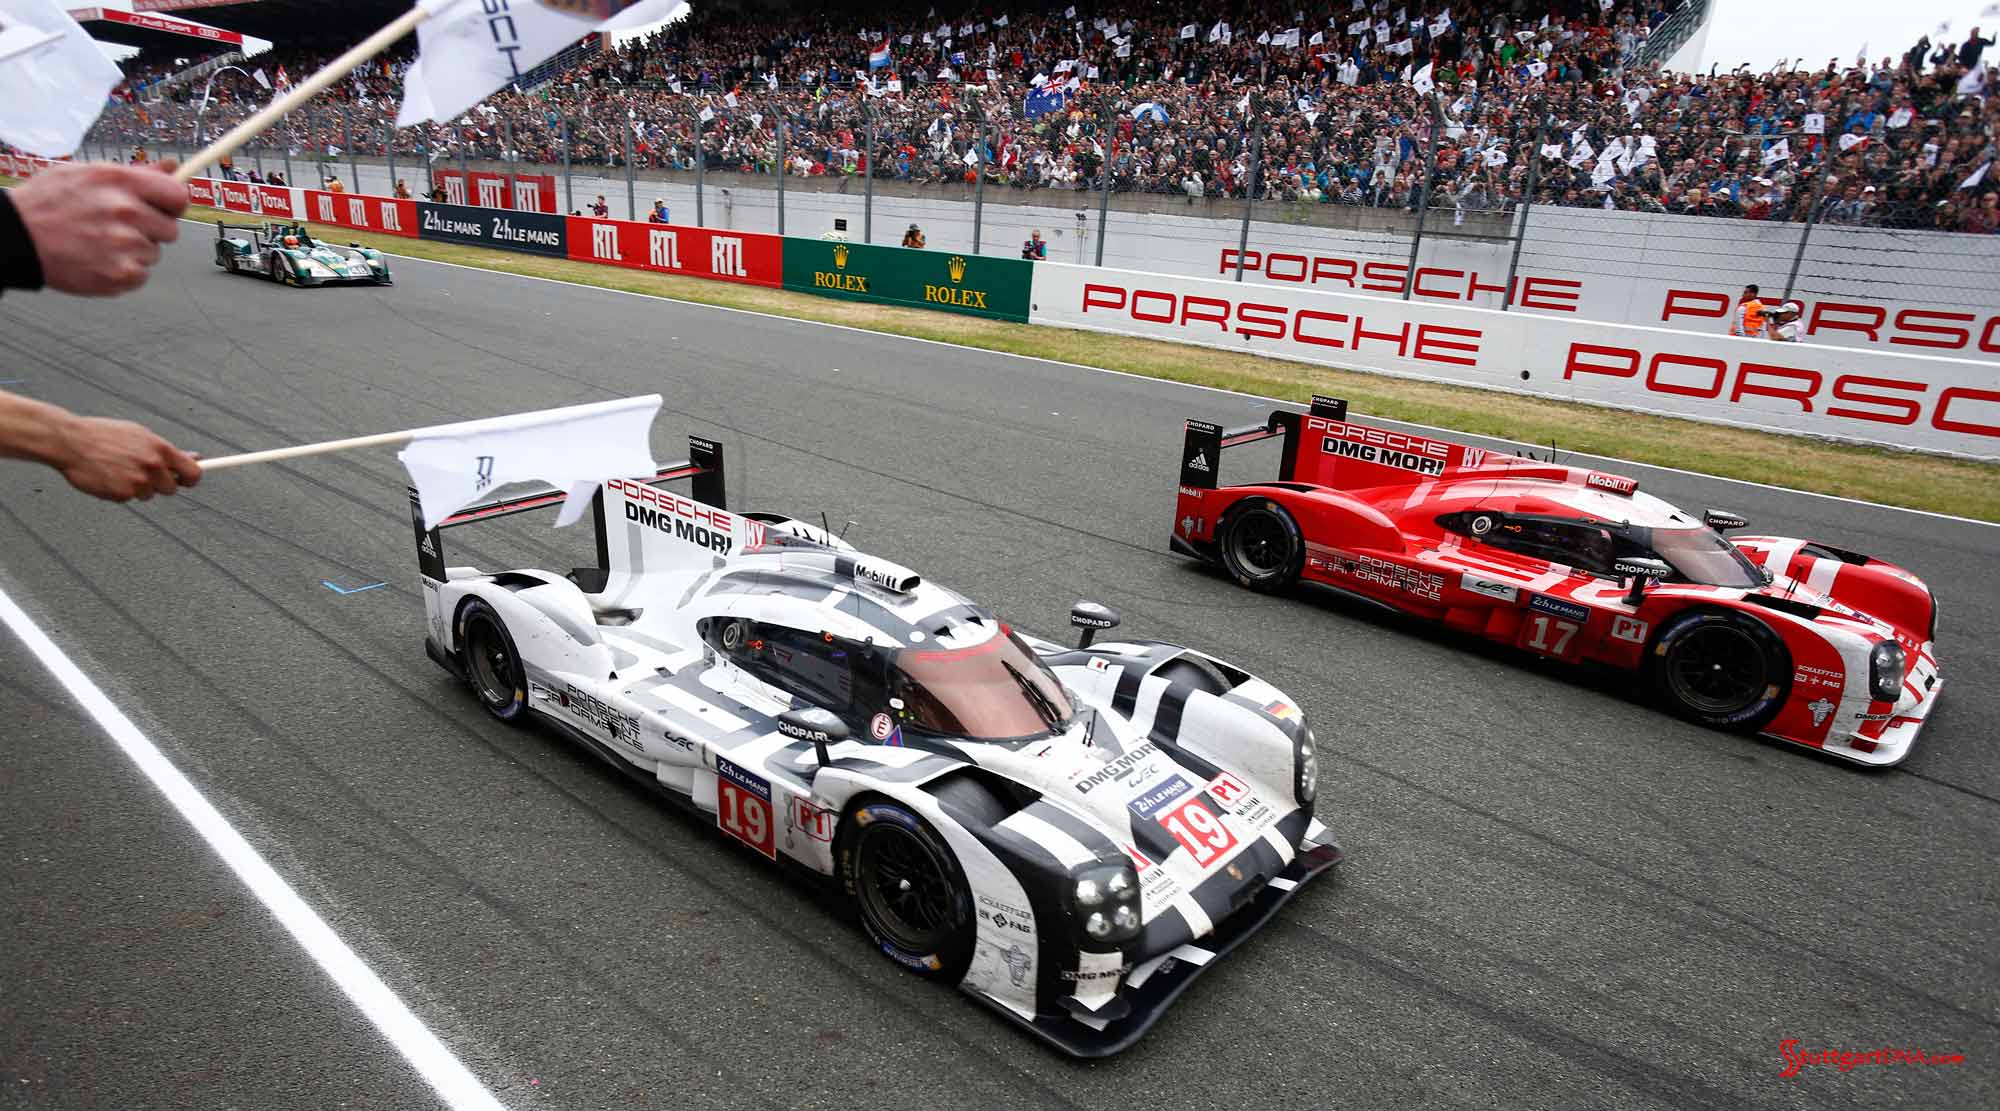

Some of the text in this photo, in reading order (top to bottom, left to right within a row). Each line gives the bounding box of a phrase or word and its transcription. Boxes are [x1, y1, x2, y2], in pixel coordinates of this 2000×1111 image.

[222, 188, 250, 205] TOTAL
[260, 192, 290, 211] TOTAL
[318, 195, 337, 222] RTL
[349, 198, 368, 226] RTL
[380, 202, 402, 231] RTL
[442, 219, 452, 233] LE
[454, 222, 482, 236] MANS
[512, 228, 526, 242] LE
[527, 231, 560, 246] MANS
[592, 223, 622, 260] RTL
[649, 228, 682, 269] RTL
[711, 235, 747, 277] RTL
[814, 271, 868, 293] ROLEX
[1220, 248, 1582, 312] PORSCHE
[925, 285, 987, 309] ROLEX
[1082, 284, 1482, 367] PORSCHE
[1186, 420, 1215, 431] CHOPARD
[1307, 418, 1449, 457] PORSCHE
[1323, 438, 1376, 462] DMG
[1188, 461, 1210, 473] adidas
[1587, 474, 1618, 489] Mobil
[607, 479, 732, 533] PORSCHE
[625, 501, 672, 534] DMG
[1708, 518, 1744, 527] CHOPARD
[856, 564, 886, 585] Mobil
[1360, 554, 1444, 585] PORSCHE
[1614, 563, 1668, 577] CHOPARD
[1071, 614, 1111, 628] CHOPARD
[1559, 607, 1585, 617] MANS
[1528, 616, 1579, 655] 17
[1616, 620, 1642, 640] P1
[1822, 679, 1841, 689] FAG
[567, 683, 641, 729] PORSCHE
[663, 731, 695, 752] WEC
[745, 777, 769, 795] MANS
[1075, 764, 1120, 795] DMG
[1211, 778, 1242, 801] P1
[723, 786, 768, 845] 19
[1167, 803, 1230, 865] 19
[1010, 920, 1031, 934] FAG
